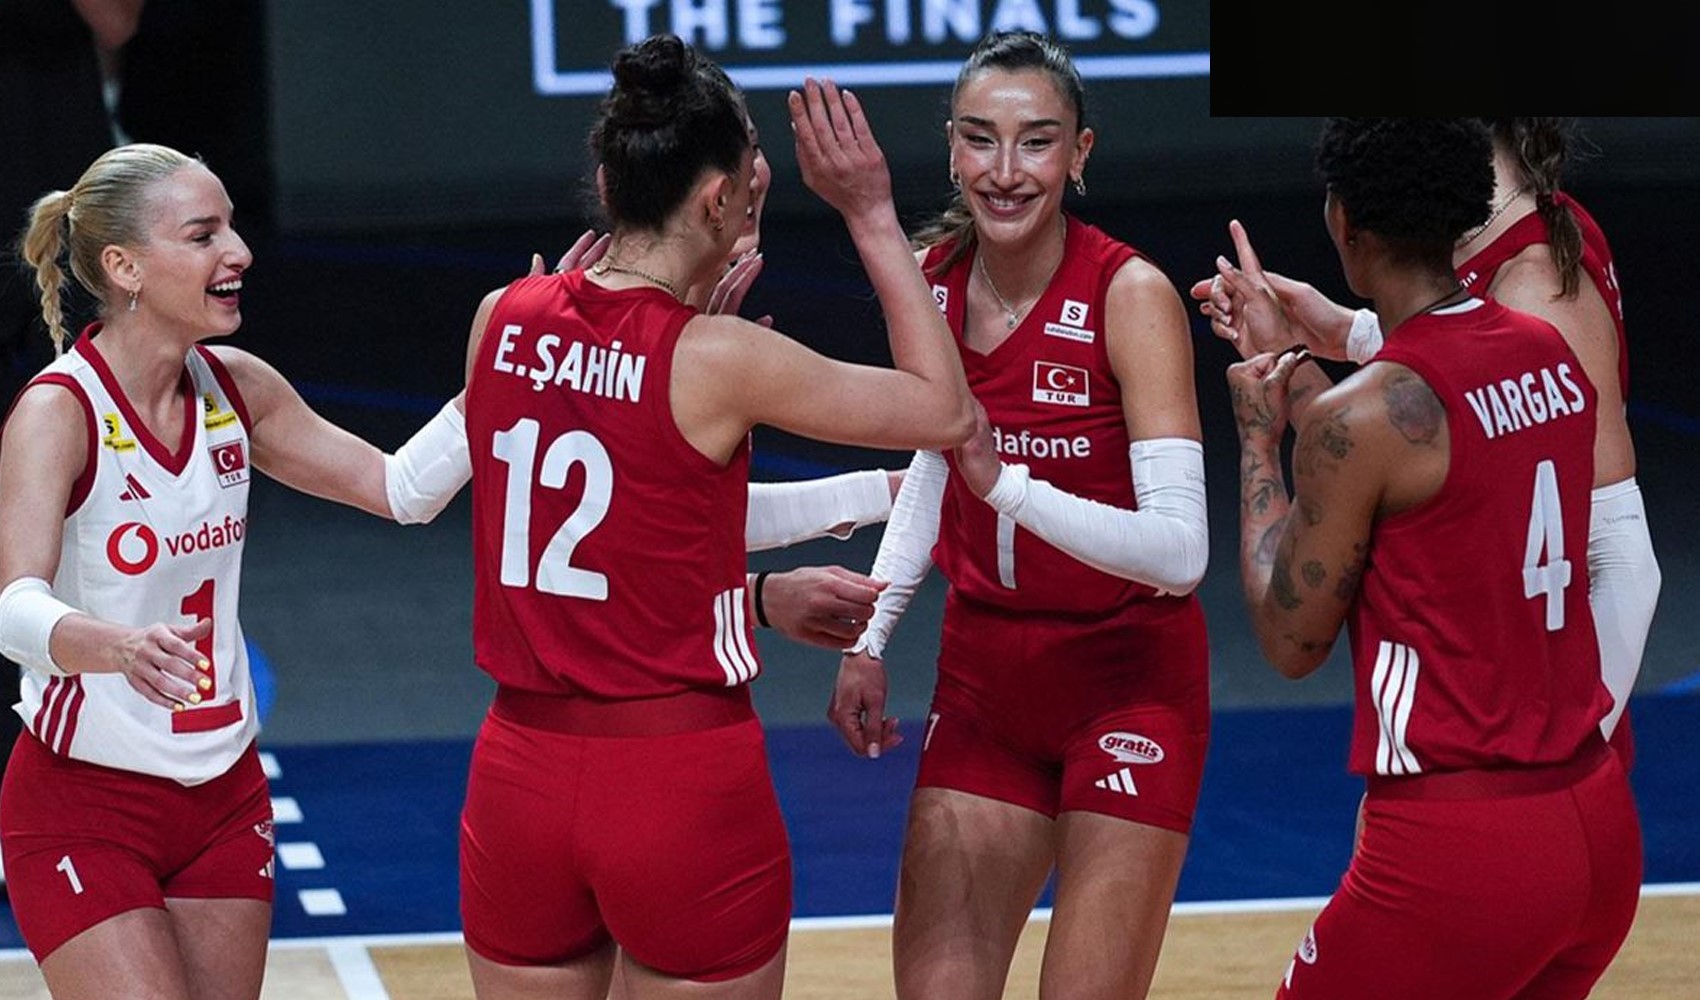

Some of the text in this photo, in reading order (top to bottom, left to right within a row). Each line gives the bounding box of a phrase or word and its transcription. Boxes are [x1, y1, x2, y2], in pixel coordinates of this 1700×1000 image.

[611, 0, 1160, 50] THE FINALS
[1067, 305, 1081, 321] S
[493, 323, 646, 403] E.ŞAHİN
[1046, 392, 1076, 403] TUR
[1464, 362, 1585, 439] VARGAS
[492, 417, 614, 601] 12
[1522, 459, 1572, 631] 4
[181, 578, 217, 701] 1
[1103, 736, 1159, 758] gratis
[56, 855, 84, 895] 1
